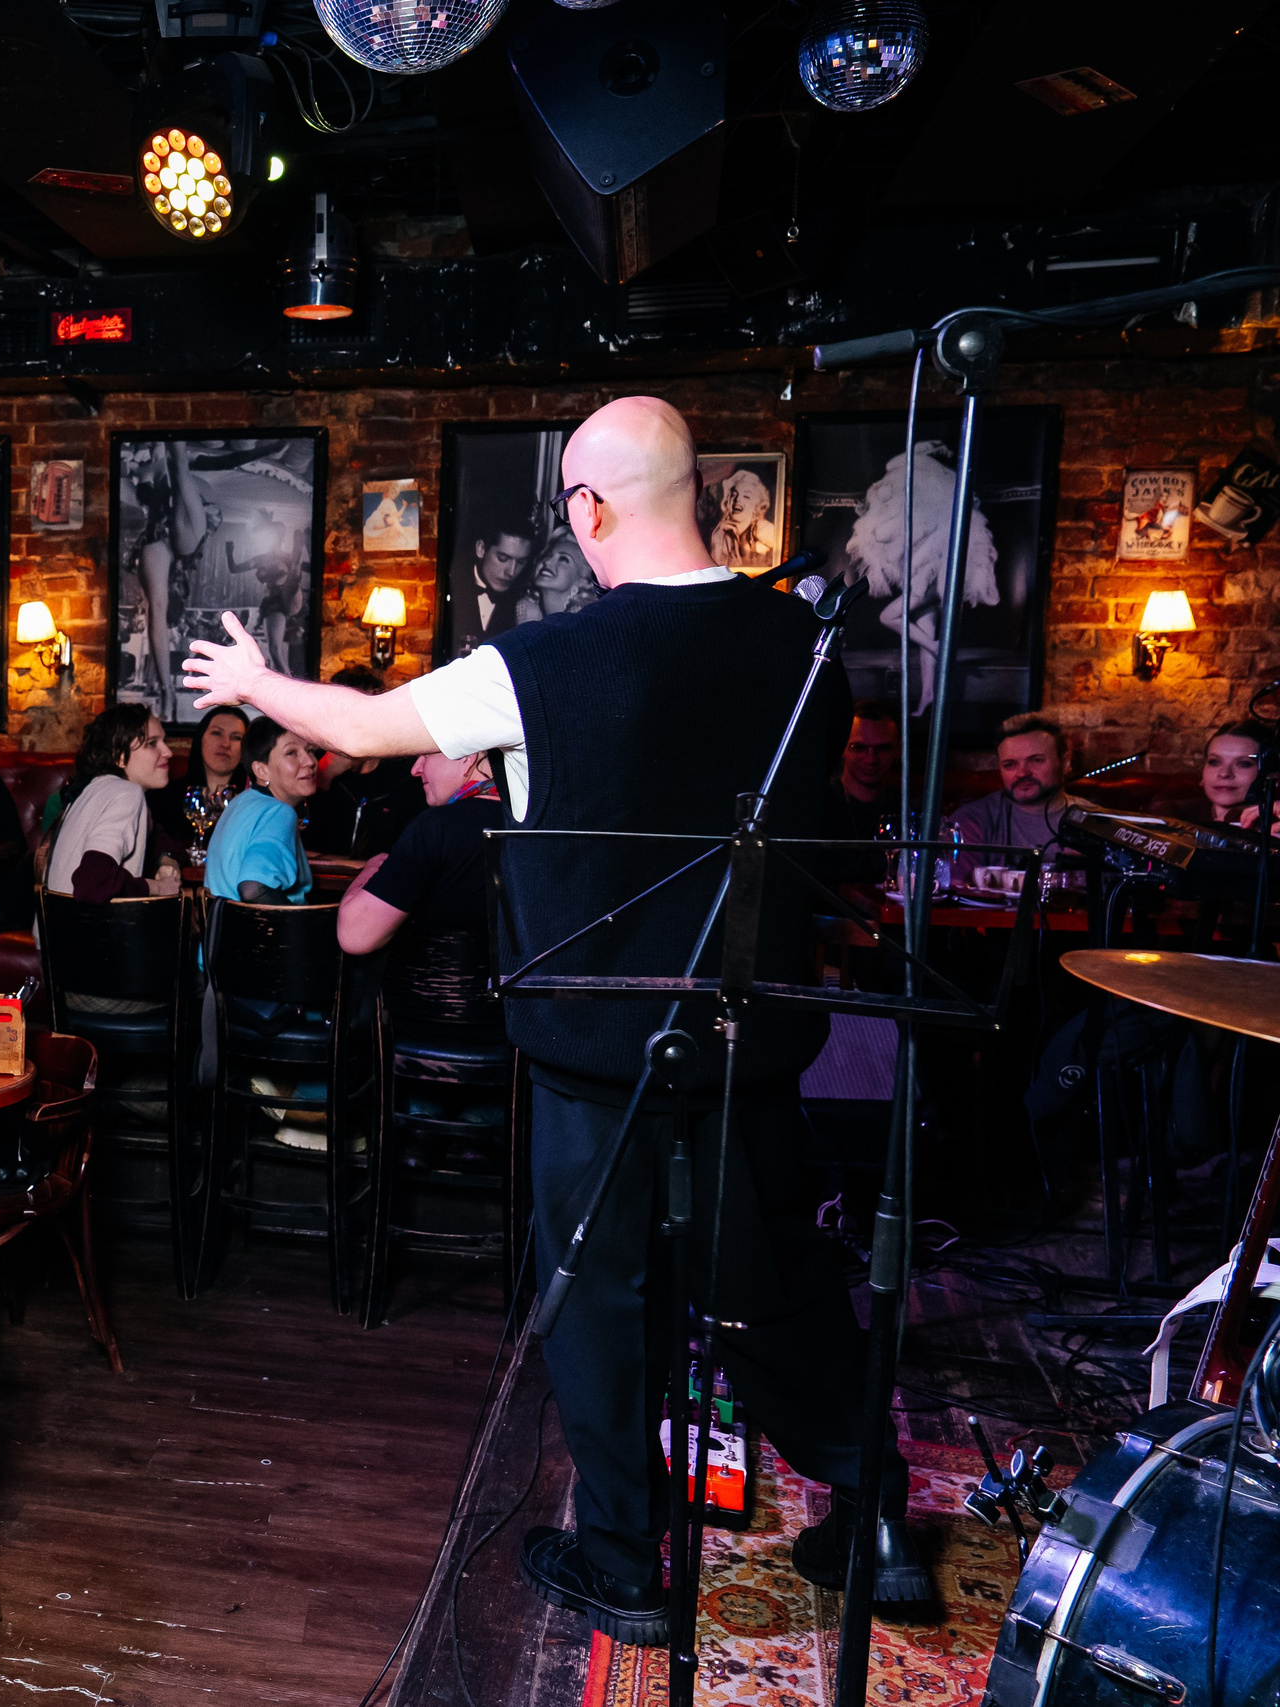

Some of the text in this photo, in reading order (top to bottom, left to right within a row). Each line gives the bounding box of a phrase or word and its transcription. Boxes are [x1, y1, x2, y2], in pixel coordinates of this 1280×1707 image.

[1130, 475, 1186, 488] COWBOY
[1114, 827, 1171, 856] MOTIF XF6
